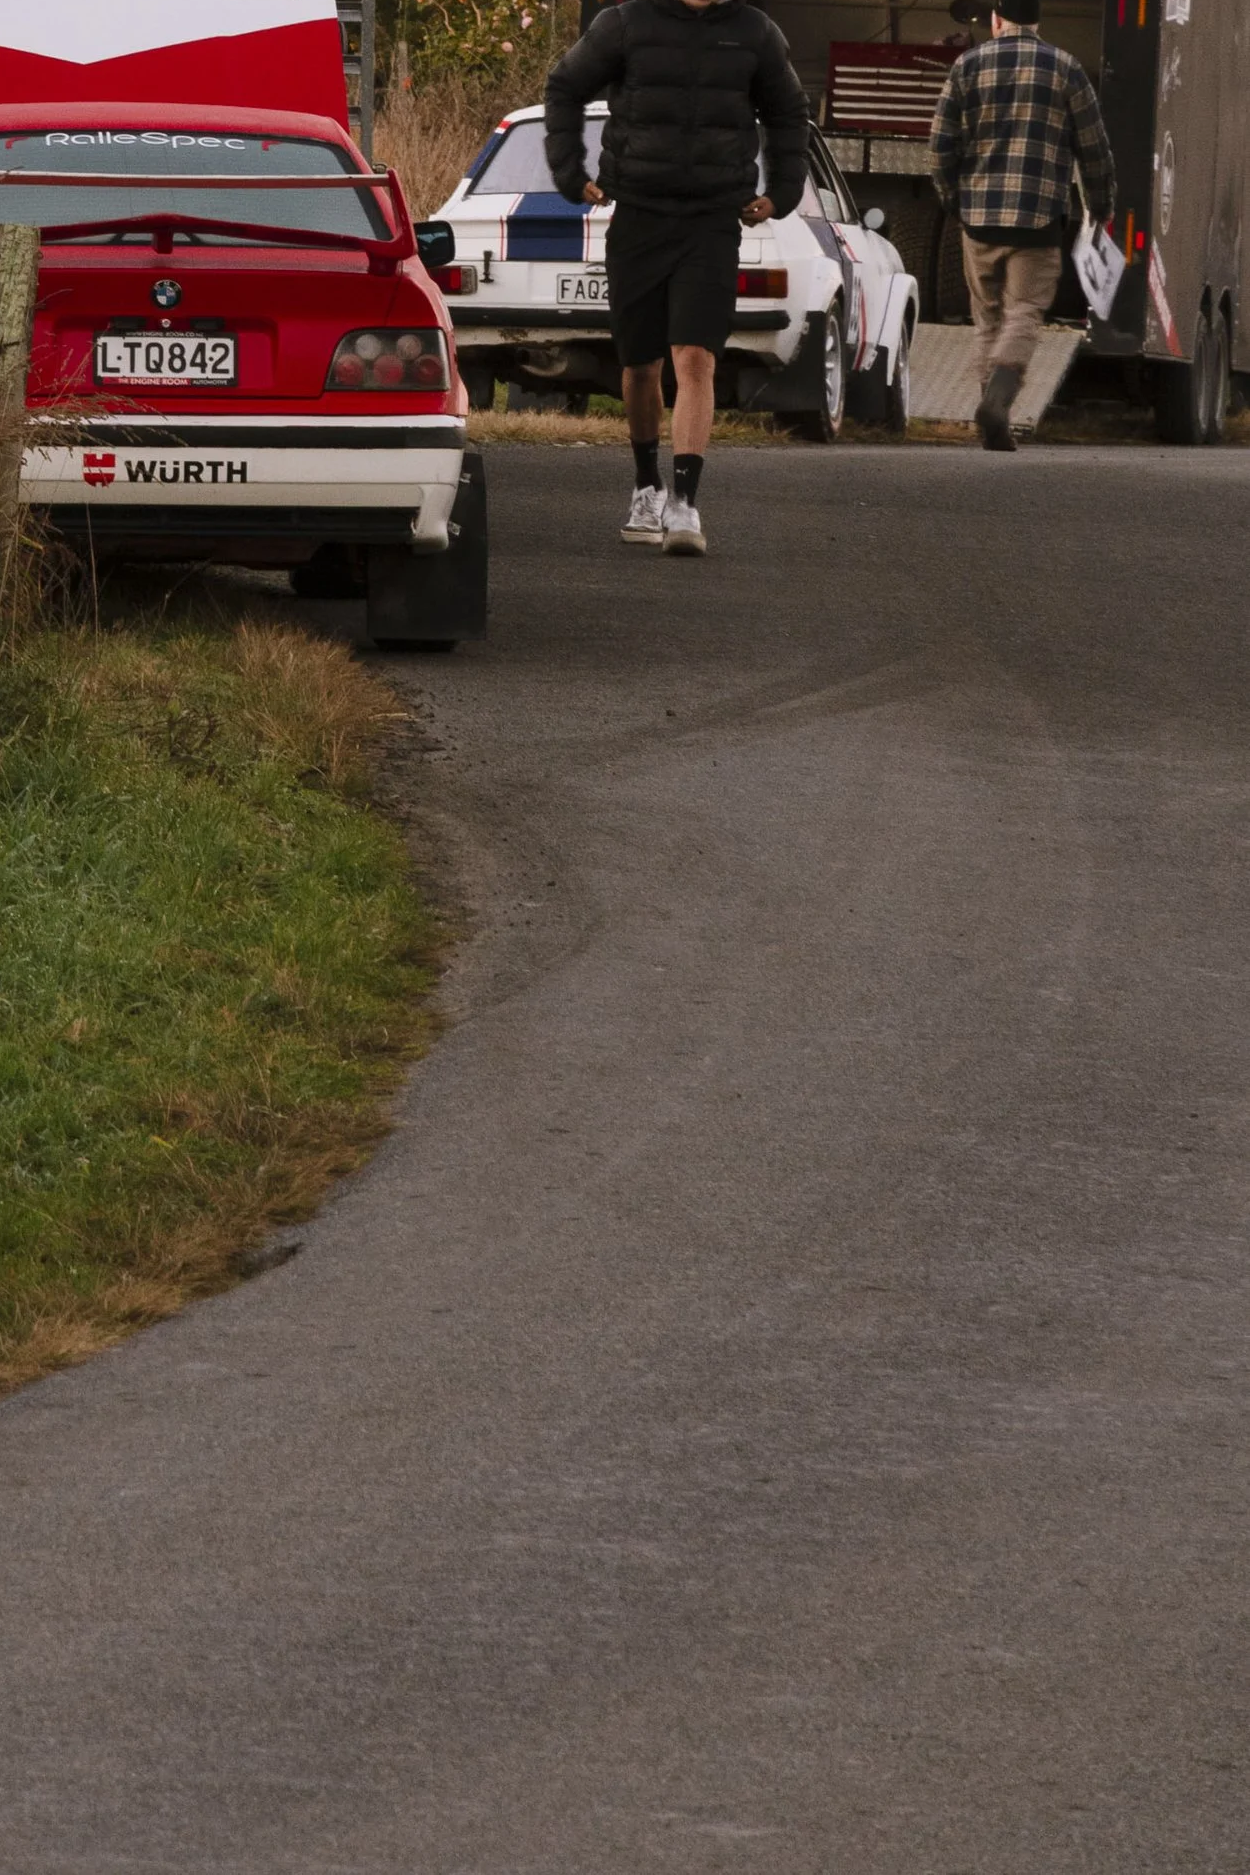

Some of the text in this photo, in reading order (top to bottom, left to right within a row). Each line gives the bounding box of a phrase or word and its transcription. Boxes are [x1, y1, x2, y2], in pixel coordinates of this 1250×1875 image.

[45, 132, 245, 149] RalleSpec
[102, 342, 229, 374] LTQ842
[130, 378, 160, 386] ENGINE
[162, 378, 188, 386] ROOM
